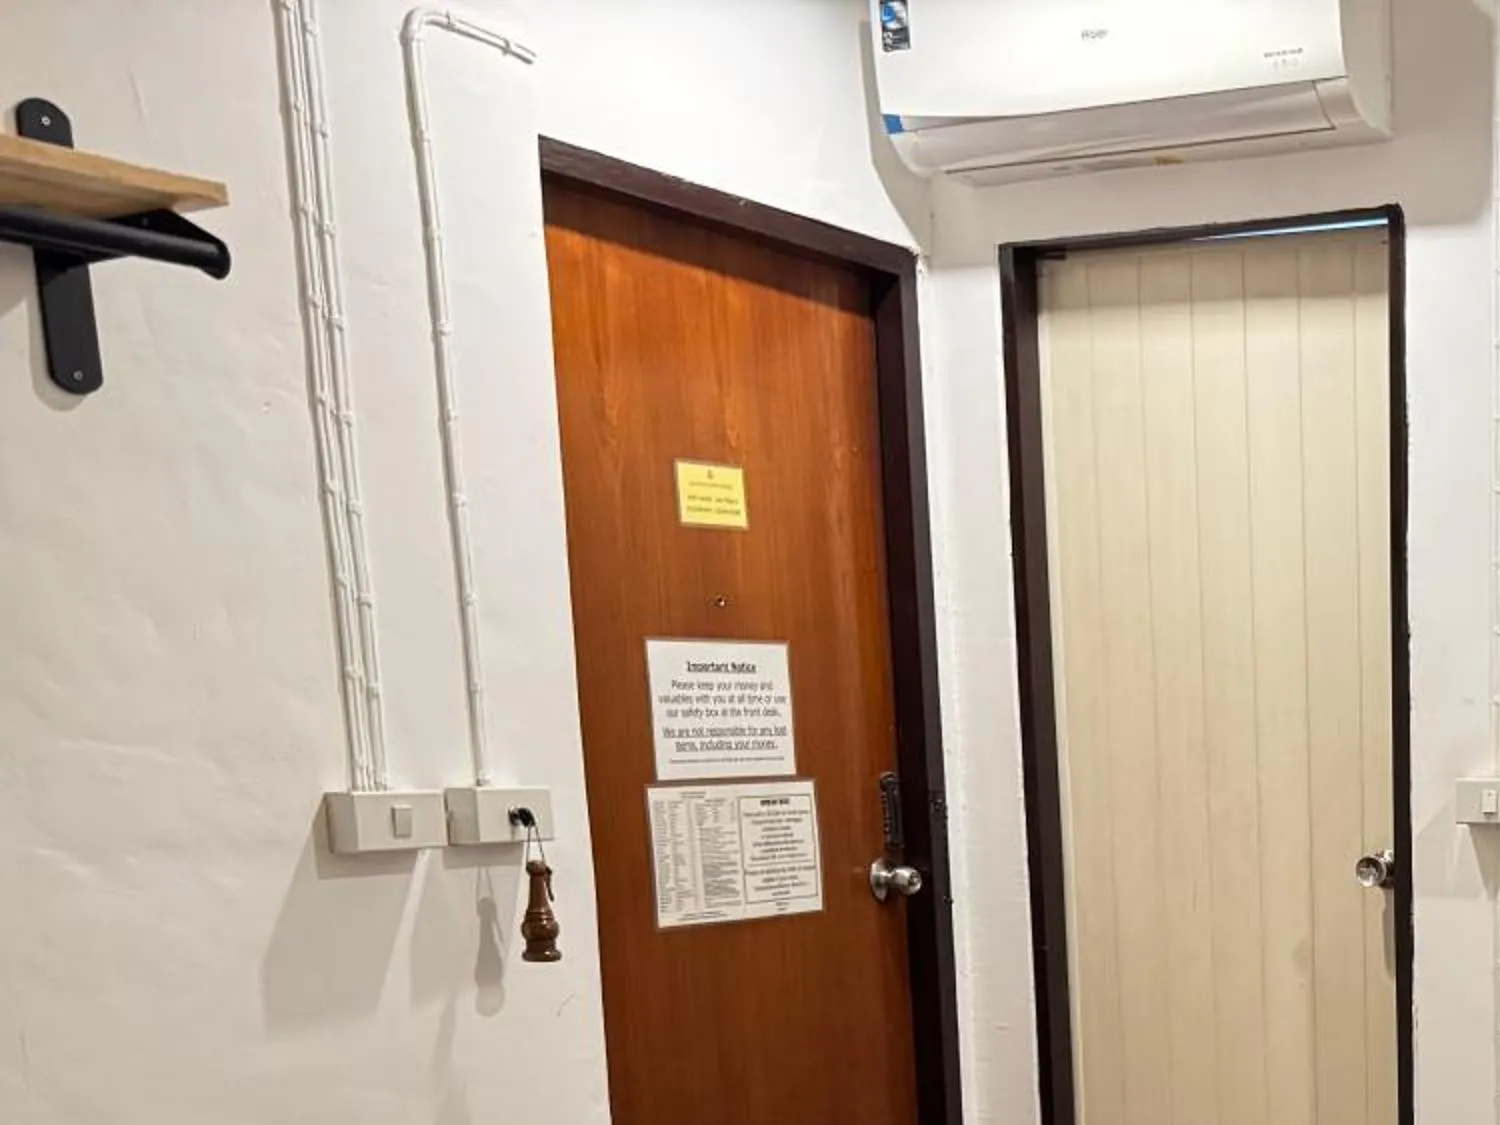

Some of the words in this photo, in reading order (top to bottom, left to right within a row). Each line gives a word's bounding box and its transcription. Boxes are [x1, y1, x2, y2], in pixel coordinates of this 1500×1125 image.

[687, 661, 730, 673] Important
[731, 662, 757, 673] Notice
[671, 680, 695, 690] Please
[696, 680, 714, 691] keep
[717, 682, 732, 691] your
[735, 682, 758, 692] money
[760, 681, 773, 690] and
[696, 694, 710, 704] with
[713, 695, 726, 705] you
